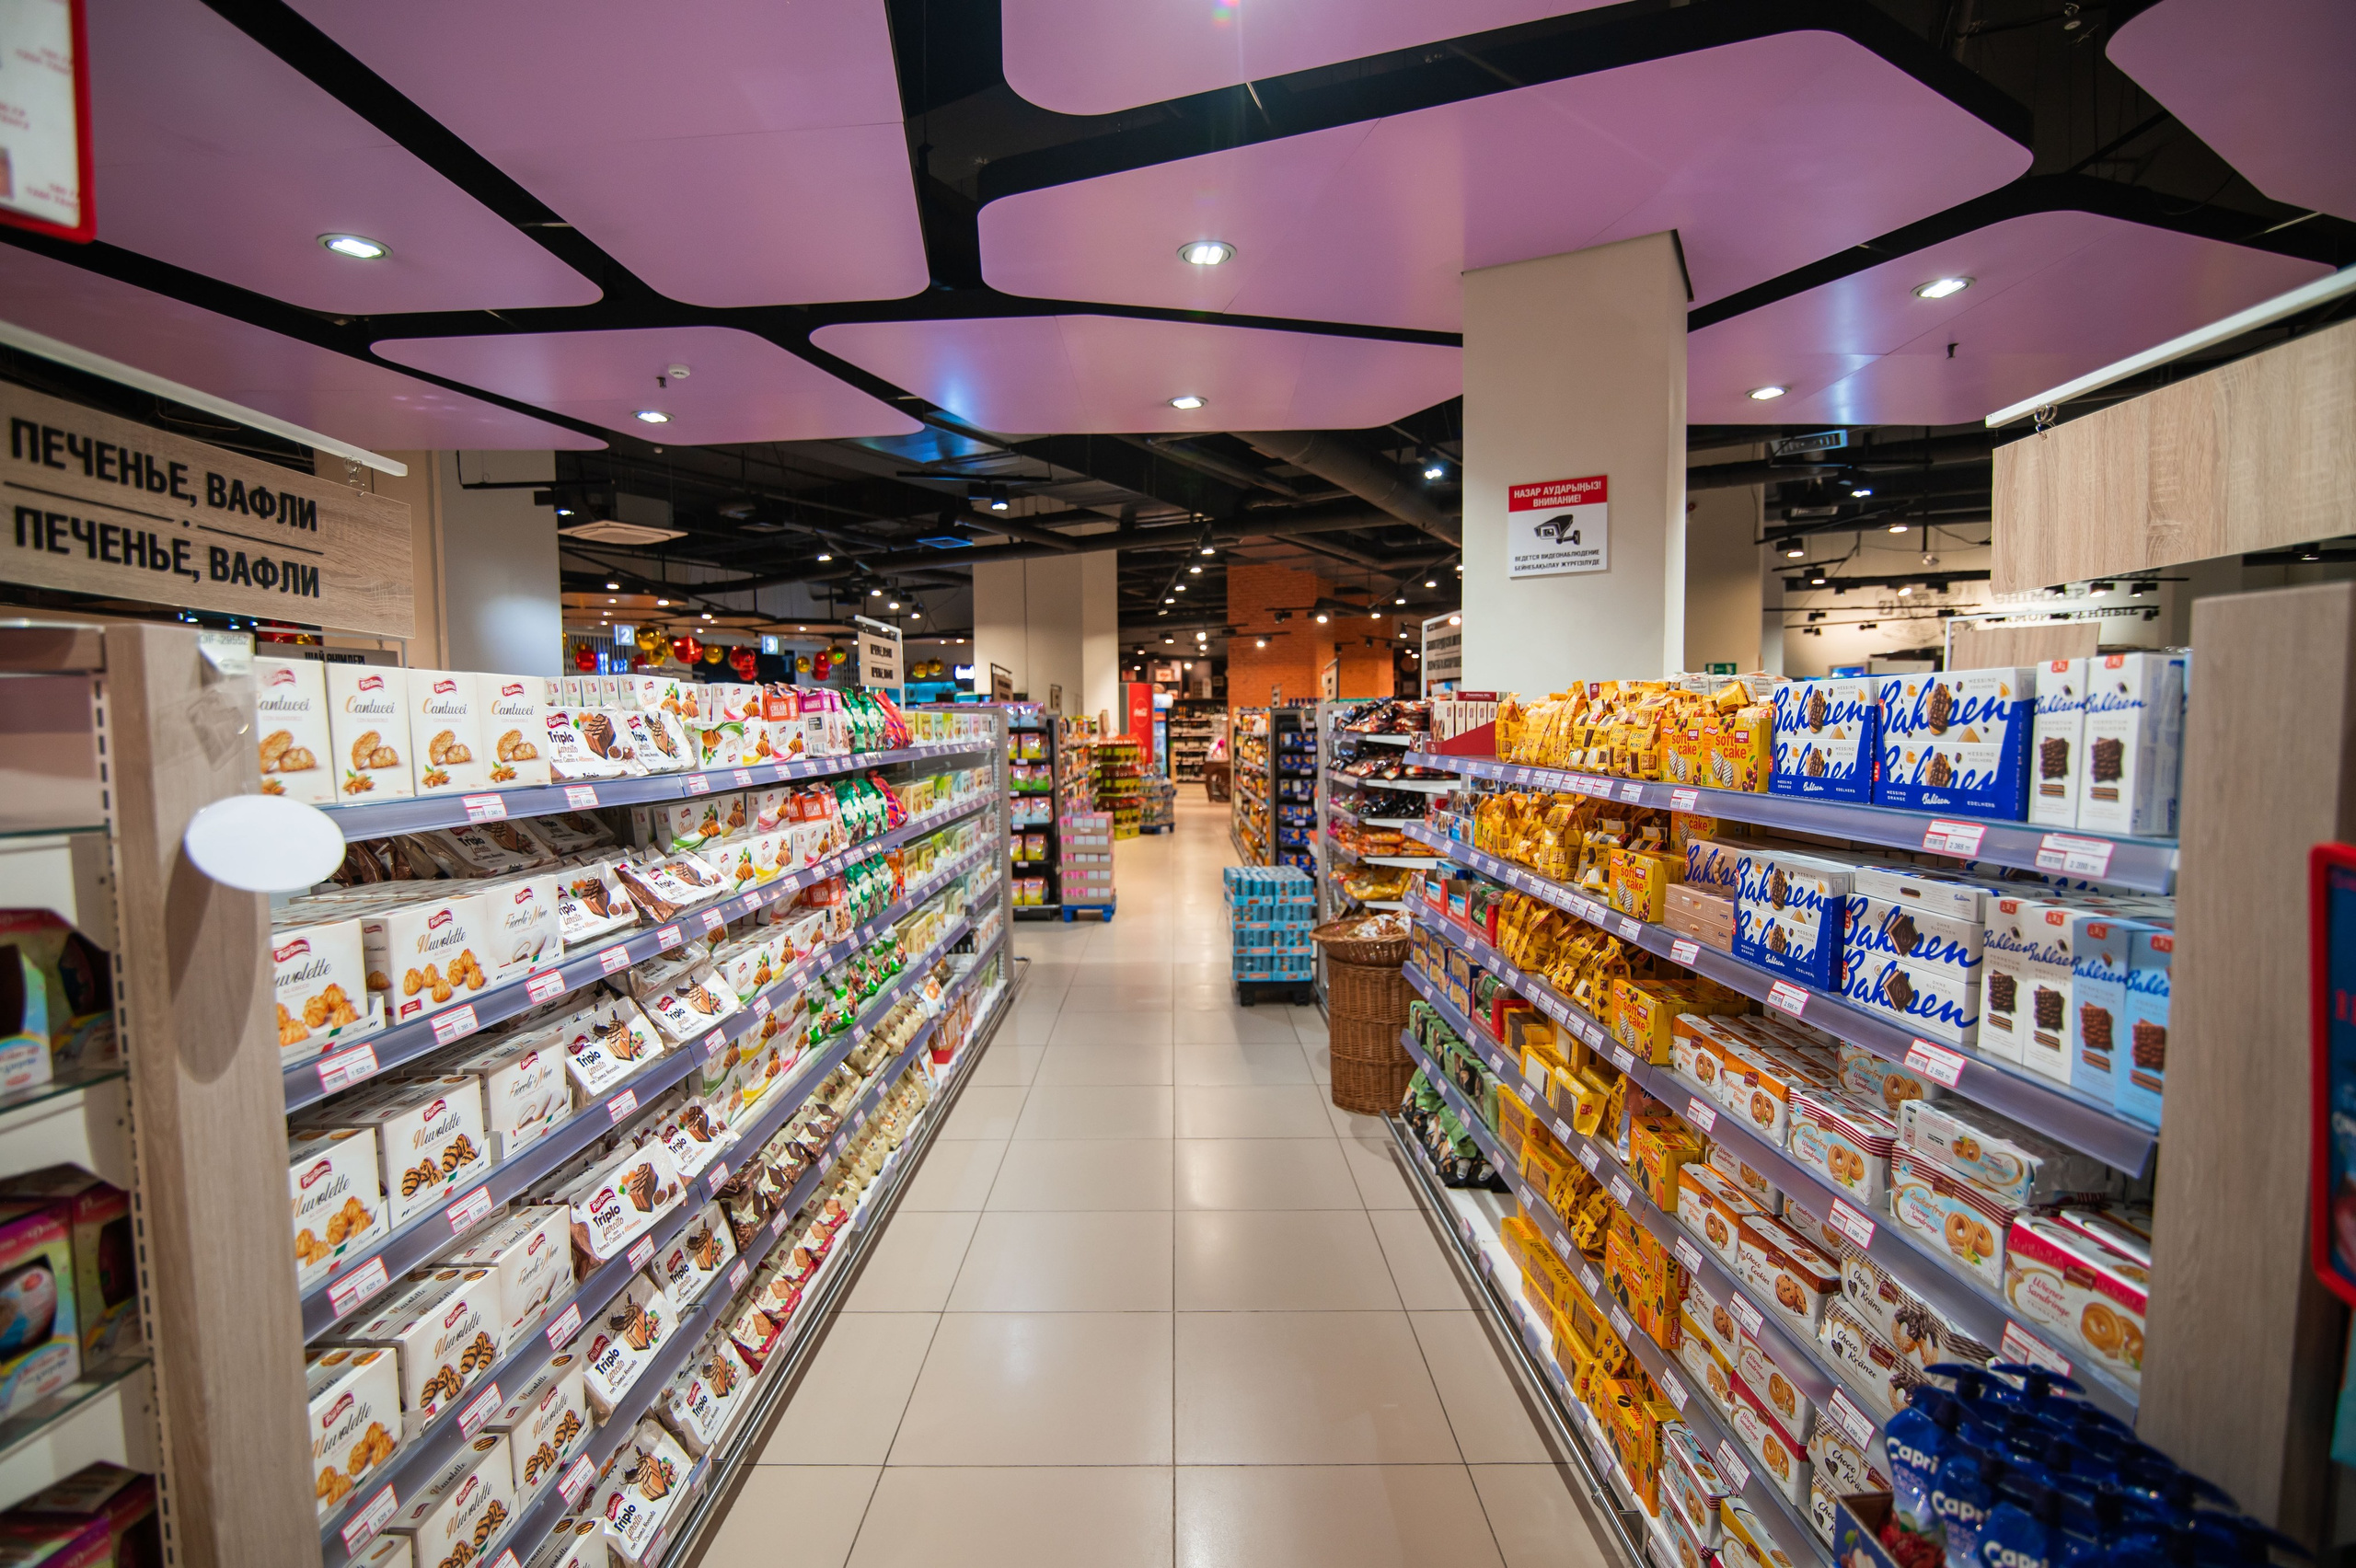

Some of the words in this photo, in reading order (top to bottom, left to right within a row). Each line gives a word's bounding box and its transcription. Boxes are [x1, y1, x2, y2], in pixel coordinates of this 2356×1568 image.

[11, 417, 197, 508] ПЕЧЕНЬЕ,
[206, 471, 318, 532] ВАФЛИ
[1514, 488, 1542, 499] НАЗАР
[1532, 494, 1581, 508] ВНИМАНИЕ!
[15, 505, 200, 583] ПЕЧЕНЬЕ,
[209, 546, 320, 598] ВАФЛИ
[1514, 554, 1540, 562] ВЕДЕТСЯ
[1541, 549, 1600, 559] ВИДЕОНАБЛЮДЕНИЕ
[620, 628, 630, 643] 2
[767, 638, 775, 651] 3
[345, 695, 396, 714] Cantucci
[423, 698, 468, 715] Cantucci
[491, 699, 535, 716] Cantucci
[2034, 694, 2085, 716] Bahlsen
[2085, 692, 2148, 715] Bahlsen
[548, 732, 574, 744] Triplo
[1671, 731, 1687, 744] soft
[1715, 732, 1735, 746] soft
[1678, 744, 1697, 755] cake
[1723, 742, 1747, 759] cake
[1922, 793, 1951, 806] Bahlsen
[1689, 818, 1708, 832] cake
[1620, 865, 1635, 879] soft
[1626, 879, 1644, 893] cake
[417, 927, 467, 954] Nuvolette
[1984, 930, 2028, 953] Bahlsen
[2029, 942, 2072, 966] Bahlse
[275, 958, 332, 988] uvolette
[2072, 956, 2125, 985] Bahlsen
[1623, 1001, 1638, 1017] soft
[1628, 1016, 1646, 1032] cake
[576, 1049, 601, 1068] Triplo
[1853, 1072, 1871, 1085] Wiener
[1854, 1081, 1878, 1096] Sandringe
[413, 1112, 461, 1150] Nuvolette
[1801, 1127, 1828, 1151] Zuckerfrei
[669, 1136, 687, 1155] Triplo
[1639, 1141, 1652, 1160] soft
[1718, 1146, 1734, 1159] Wiener
[1802, 1139, 1817, 1153] Wiener
[1716, 1150, 1736, 1168] Sandringe
[1803, 1147, 1823, 1165] Sandringe
[1643, 1157, 1658, 1177] cake
[290, 1173, 351, 1218] Nuvolette
[1909, 1189, 1946, 1219] Zuckerfrei
[593, 1205, 621, 1228] Triplo
[1795, 1202, 1817, 1223] Sandringe
[1910, 1202, 1931, 1220] Wiener
[1911, 1211, 1938, 1235] Sandringe
[1617, 1258, 1633, 1278] soft
[1746, 1252, 1761, 1268] Choco
[670, 1263, 690, 1284] Triplo
[1751, 1266, 1770, 1286] Cookies
[1853, 1269, 1871, 1291] Choco
[1622, 1275, 1640, 1299] cake
[1693, 1283, 1705, 1297] Choco
[2033, 1275, 2066, 1302] Wiener
[1695, 1295, 1710, 1313] Cookies
[1860, 1291, 1883, 1316] Kränze
[2026, 1285, 2070, 1317] Sandringe
[434, 1311, 482, 1360] Nuvolette
[1837, 1330, 1858, 1353] Choco
[595, 1346, 620, 1375] Triplo
[1745, 1357, 1765, 1381] Sandringe
[1748, 1352, 1763, 1370] Wiener
[1848, 1350, 1877, 1380] Kränze
[532, 1392, 569, 1436] Nuvolette
[692, 1394, 709, 1416] Triplo
[312, 1402, 373, 1458] Nuvolette
[1738, 1416, 1759, 1442] Sandringe
[1742, 1411, 1758, 1431] Wiener
[1832, 1450, 1856, 1473] Choco
[1887, 1437, 1940, 1474] Capri
[1843, 1471, 1865, 1494] Krän
[446, 1481, 493, 1540] Nuvolette
[1931, 1490, 1992, 1522] Capri
[614, 1503, 637, 1534] Triplo
